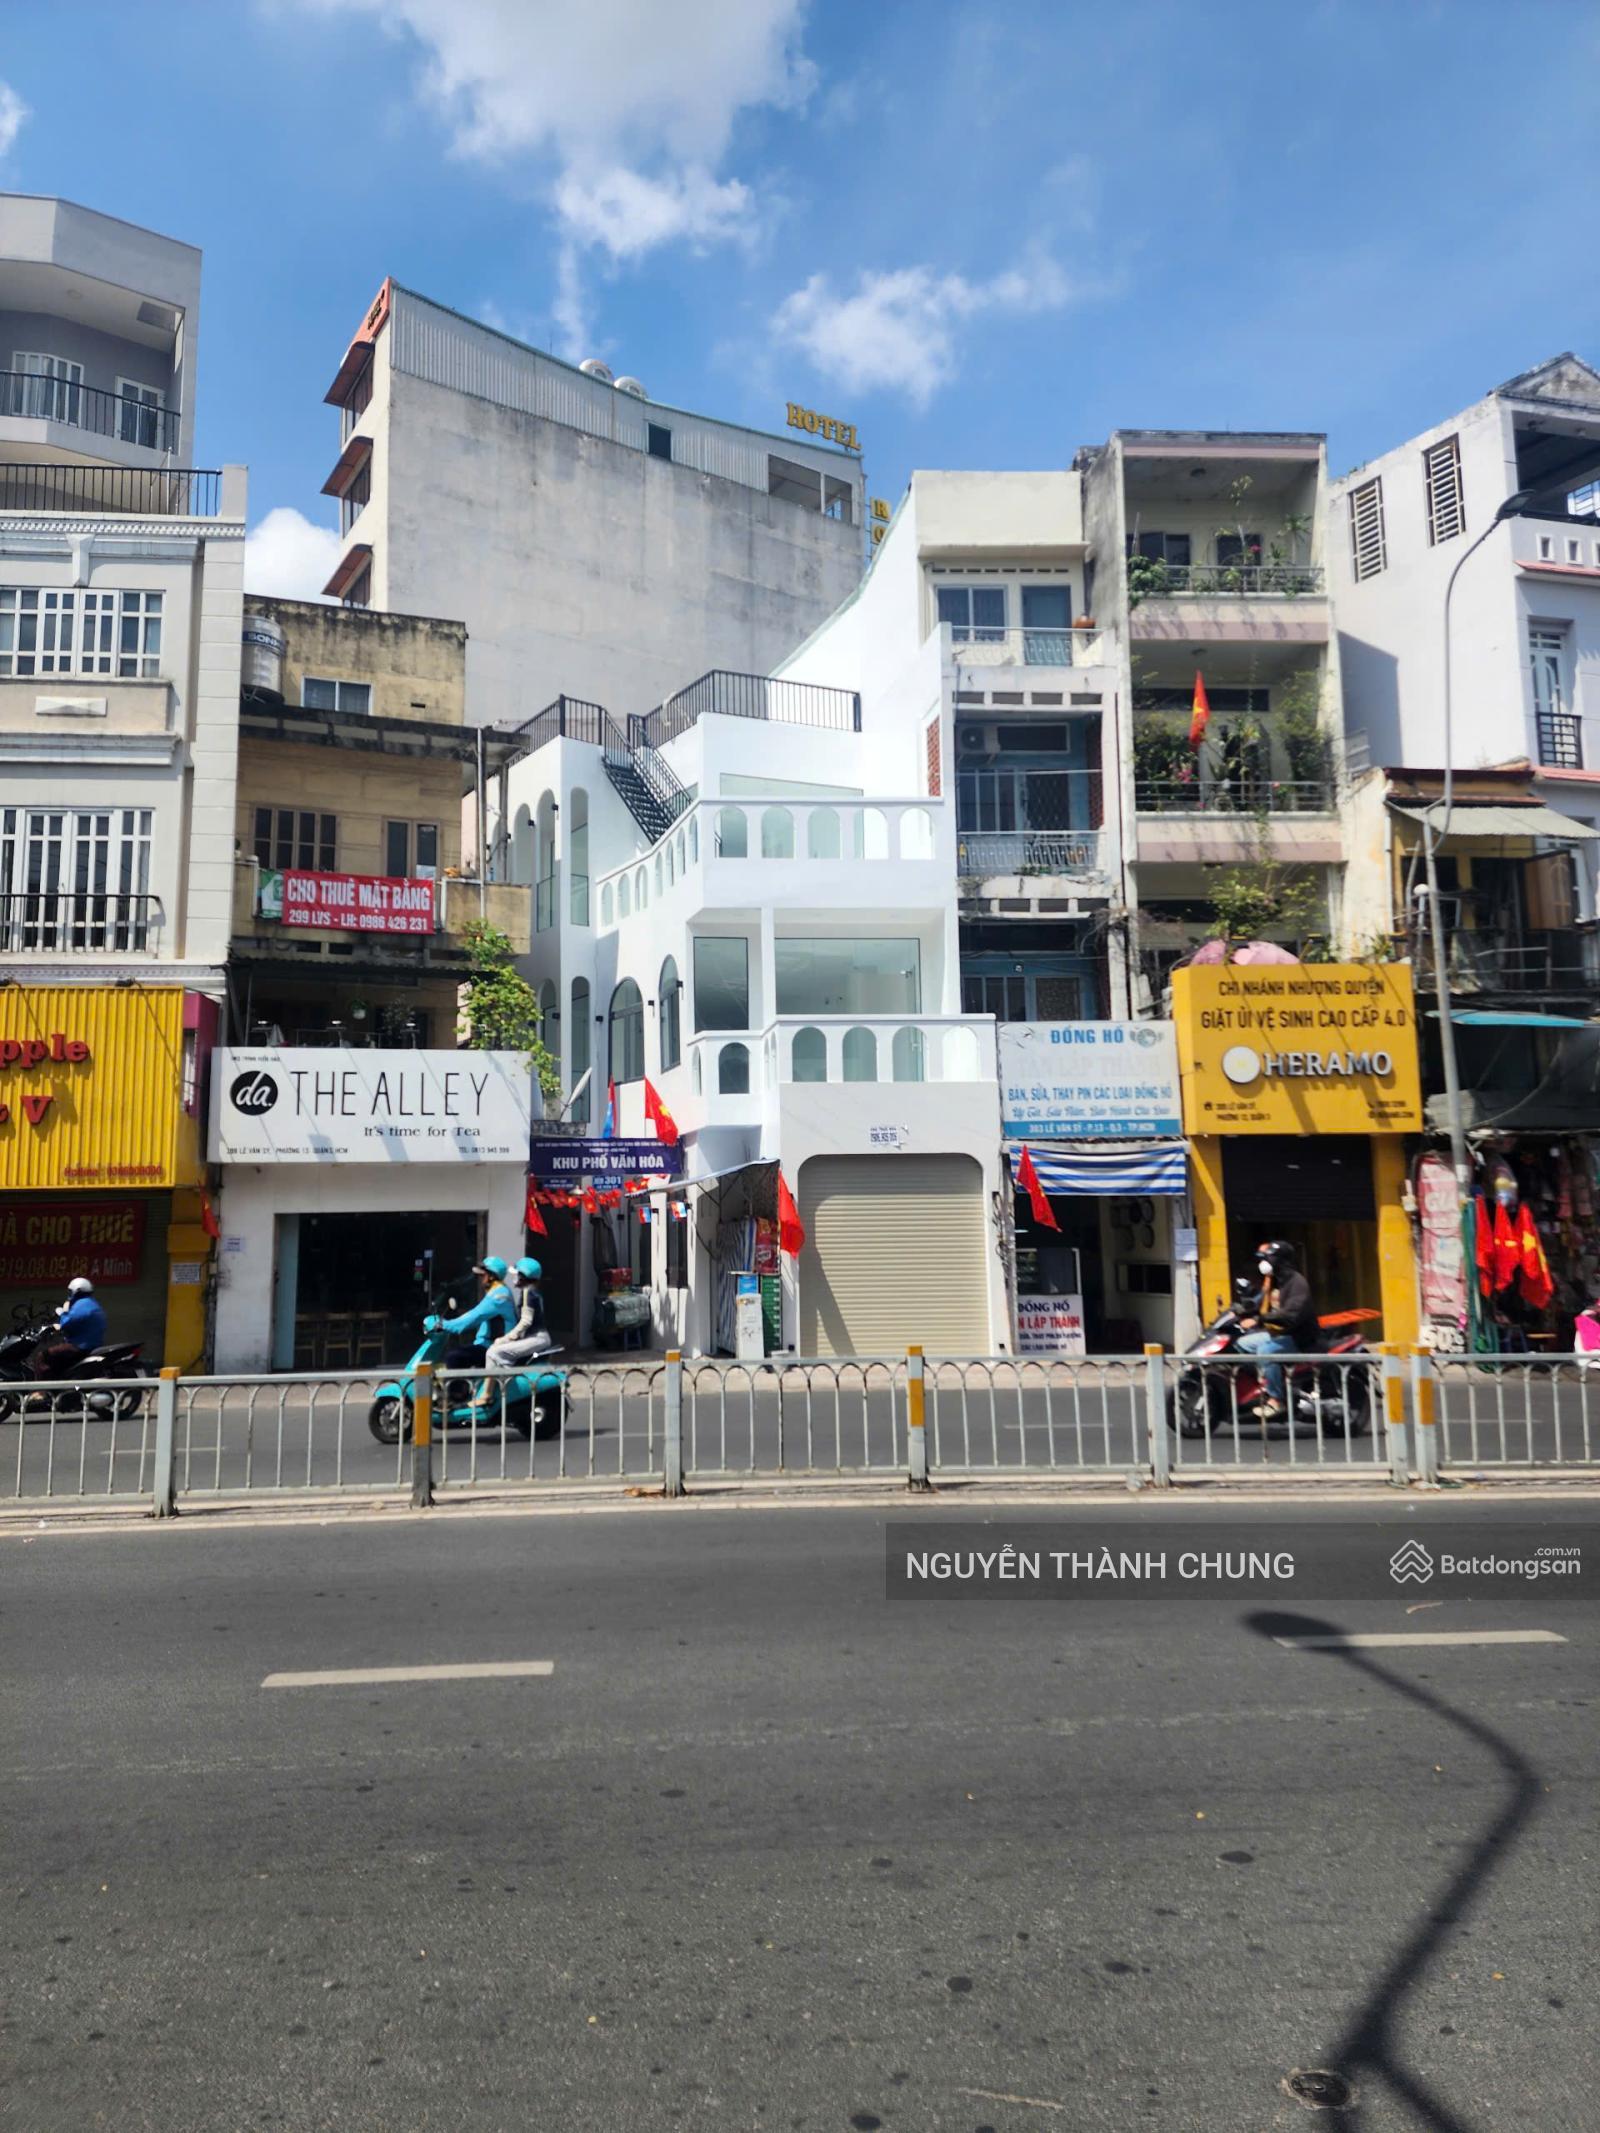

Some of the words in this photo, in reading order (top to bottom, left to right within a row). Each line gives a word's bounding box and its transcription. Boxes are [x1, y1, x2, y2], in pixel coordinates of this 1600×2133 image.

[787, 401, 861, 450] HOTEL
[287, 878, 316, 903] CHO
[359, 881, 389, 914] MẶT
[392, 877, 431, 911] BẰNG
[289, 909, 309, 923] 299
[312, 911, 331, 926] LVS
[360, 914, 385, 928] 0986
[388, 916, 407, 930] 426
[409, 917, 427, 931] 231
[1243, 977, 1285, 996] NHÁNH
[1201, 1008, 1232, 1031] GIẶT
[1279, 1010, 1314, 1028] SINH
[1318, 1010, 1346, 1028] CAO
[1351, 1004, 1379, 1027] CẤP
[1384, 1010, 1406, 1027] 4.0
[1051, 1025, 1095, 1044] ĐỒNG
[1103, 1024, 1124, 1043] HỒ
[1264, 1051, 1392, 1077] HERAMO
[290, 1071, 358, 1117] THE
[371, 1071, 489, 1117] ALLEY
[1053, 1086, 1075, 1101] THAY
[1078, 1086, 1091, 1100] PIN
[20, 1095, 53, 1126] V
[364, 1125, 384, 1137] It's
[389, 1126, 420, 1137] time
[428, 1126, 447, 1137] for
[455, 1126, 481, 1137] Tea
[552, 1157, 579, 1170] KHU
[582, 1153, 608, 1169] PHỐ
[610, 1154, 637, 1169] VĂN
[639, 1154, 665, 1168] HÓA
[604, 1176, 621, 1185] 301
[26, 1215, 72, 1245] CHO
[79, 1208, 135, 1244] THUÊ
